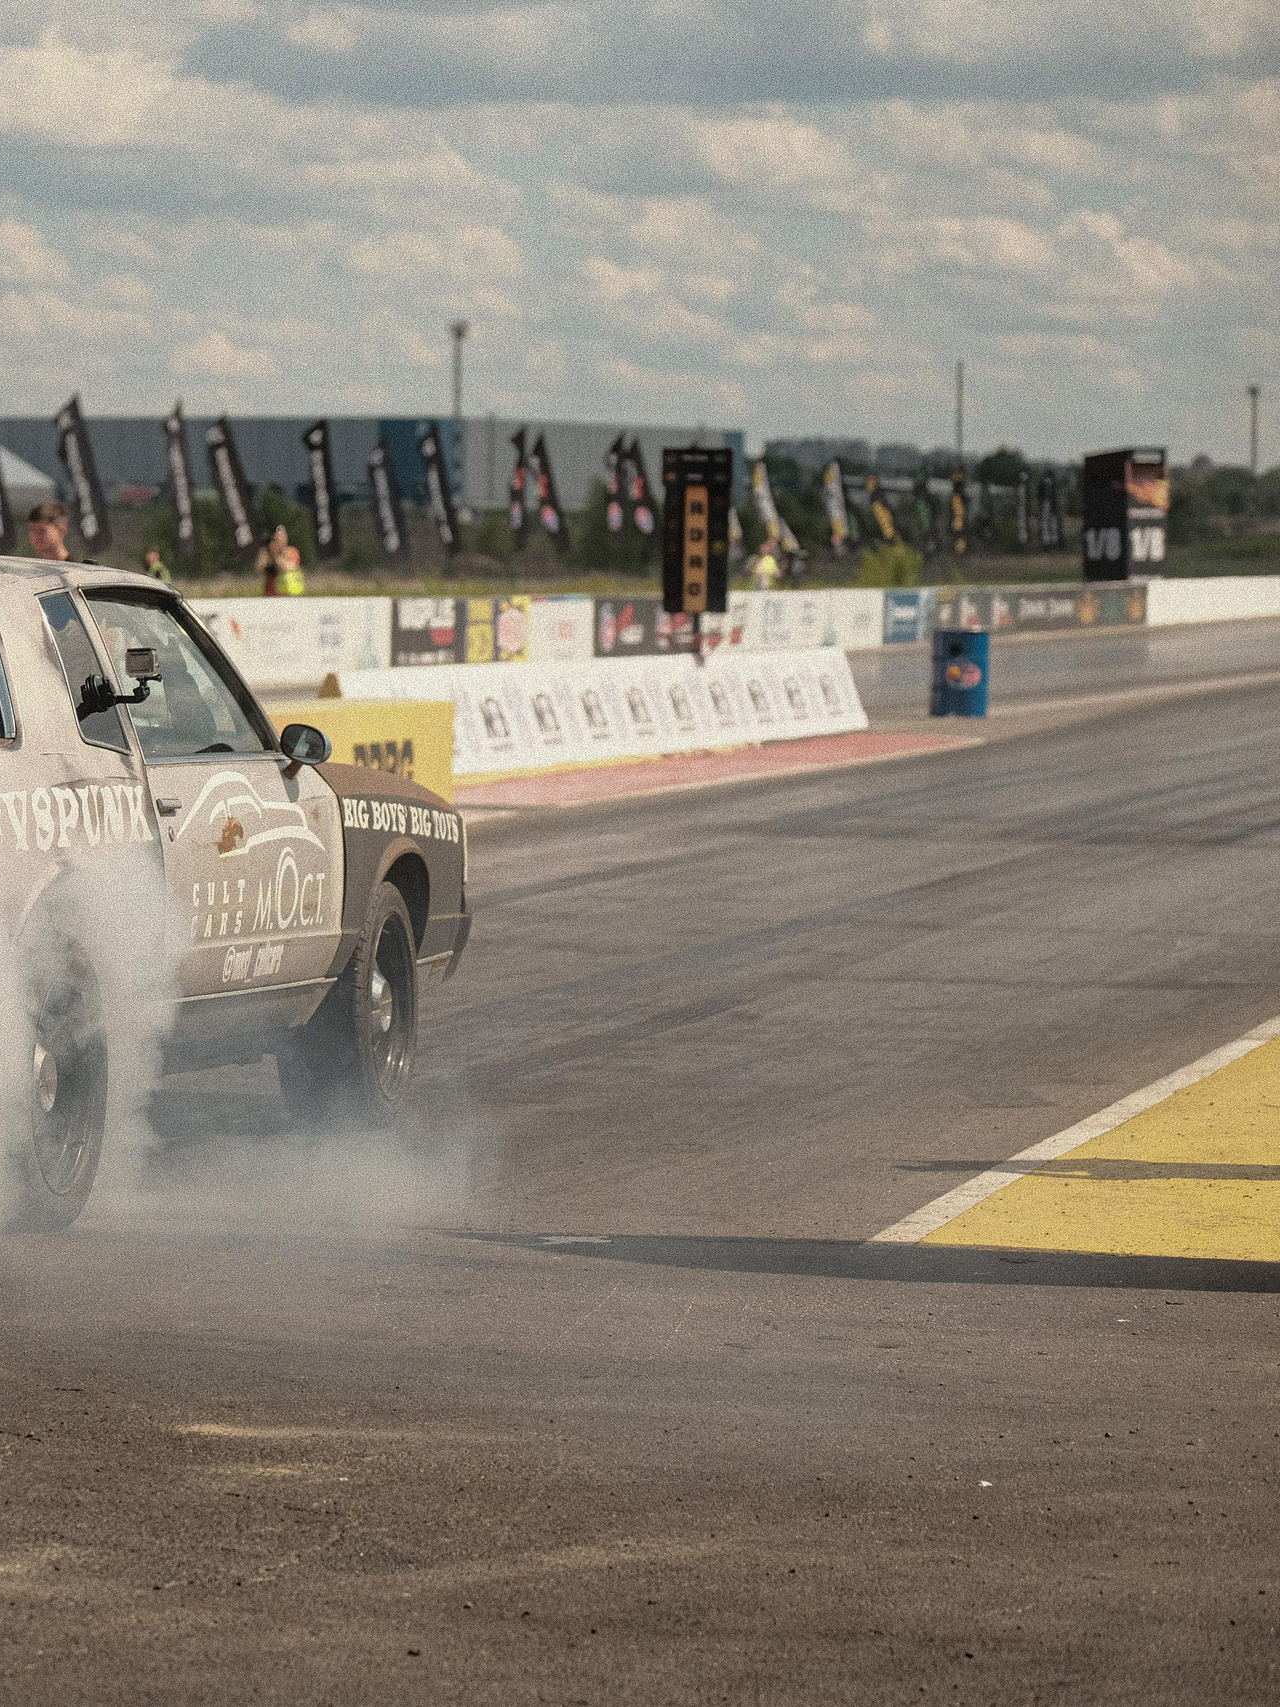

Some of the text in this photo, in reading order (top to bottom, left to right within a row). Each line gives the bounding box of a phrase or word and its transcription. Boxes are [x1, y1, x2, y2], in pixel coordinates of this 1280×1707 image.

[342, 797, 369, 830] BIG
[409, 805, 431, 837] BIG
[432, 809, 459, 844] TOYS
[193, 879, 246, 907] CULT
